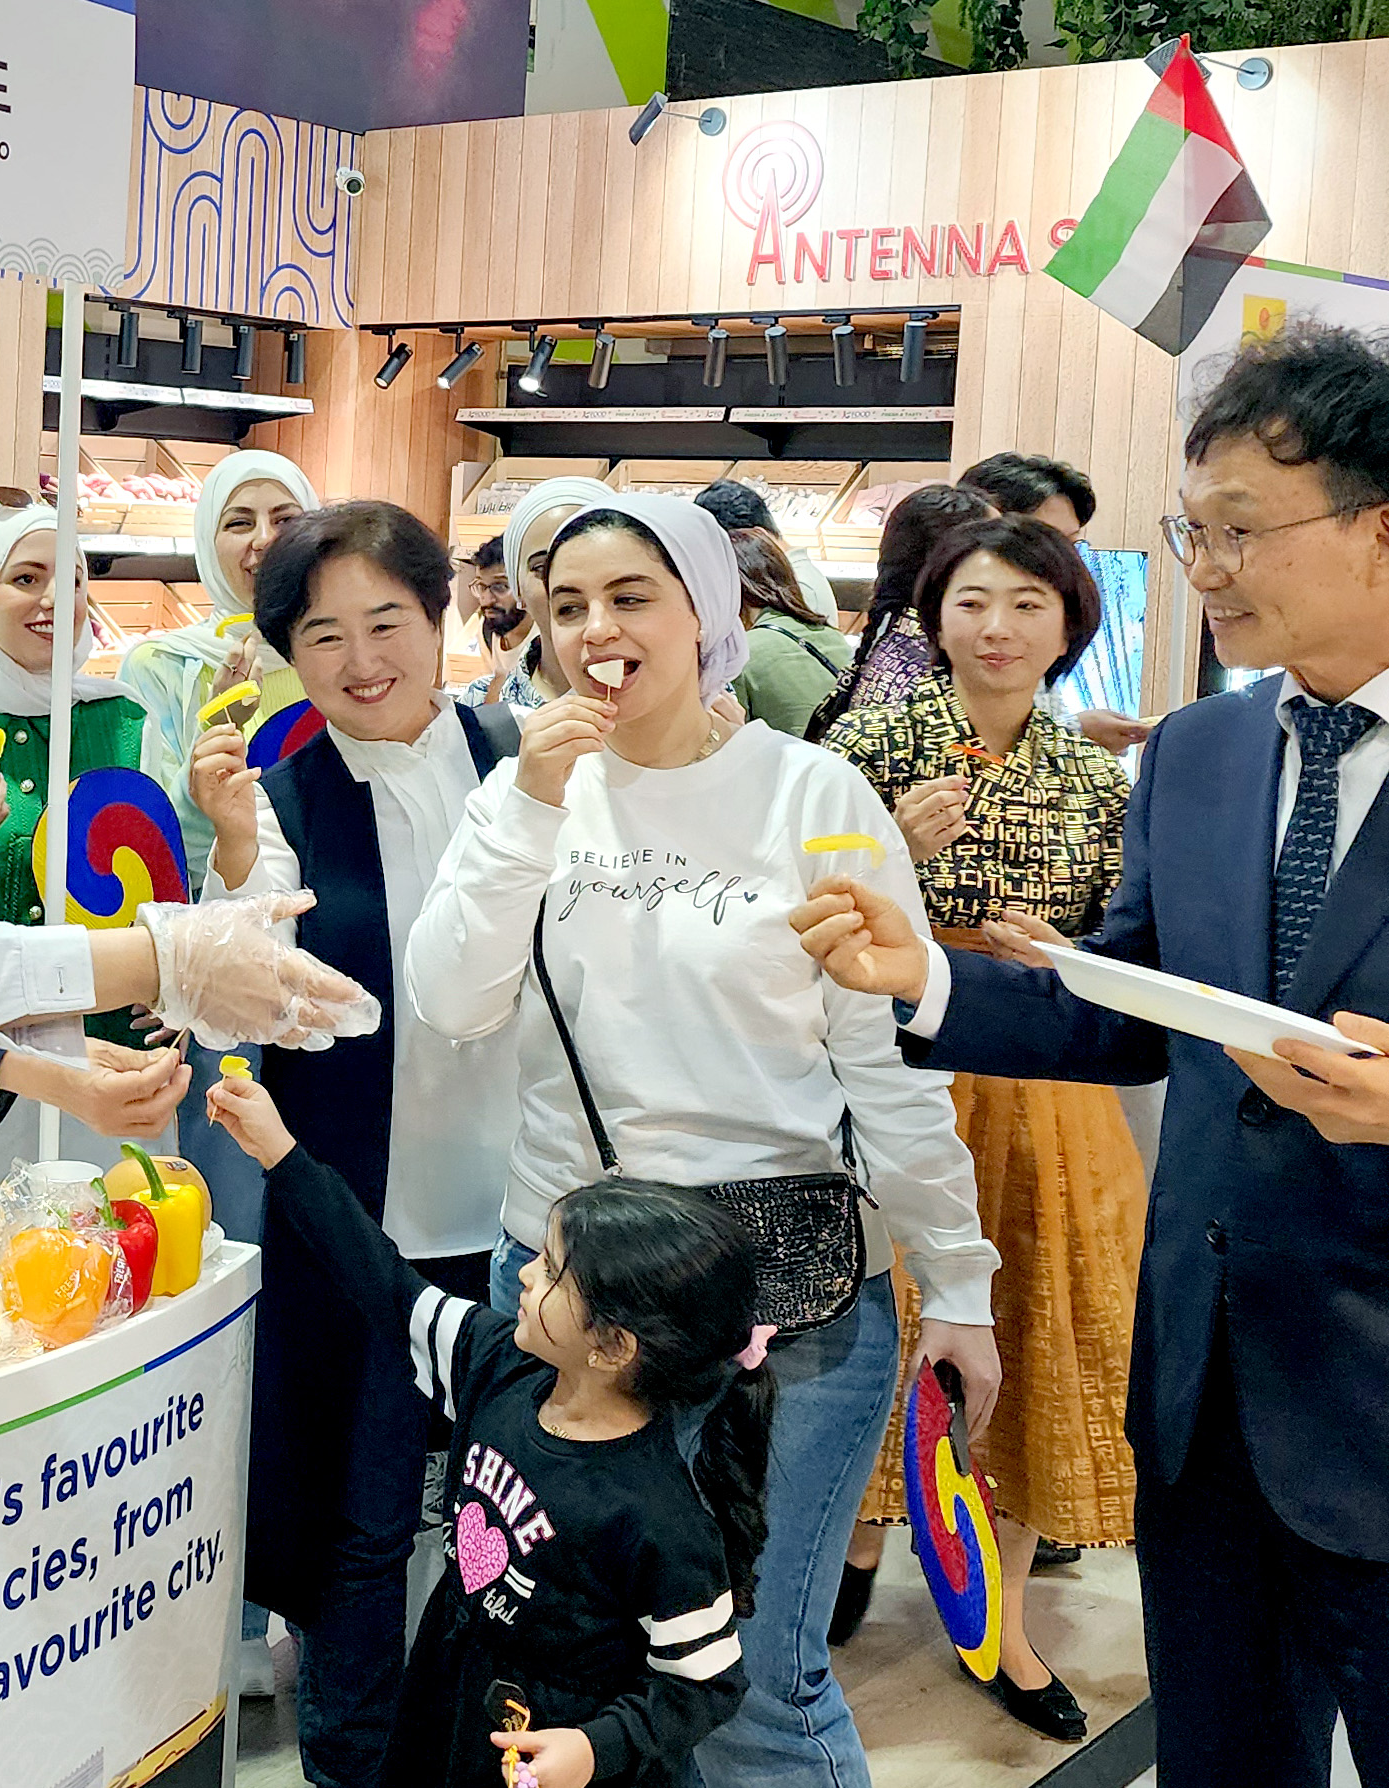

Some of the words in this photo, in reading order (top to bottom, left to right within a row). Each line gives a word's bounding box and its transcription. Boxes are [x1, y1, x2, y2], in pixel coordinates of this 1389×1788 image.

[570, 849, 653, 869] BELIEVE
[666, 852, 687, 867] IN
[557, 870, 743, 926] yourself
[41, 1391, 204, 1509] favourite
[114, 1475, 193, 1557] from
[463, 1442, 556, 1557] SHINE
[168, 1528, 225, 1600] city.
